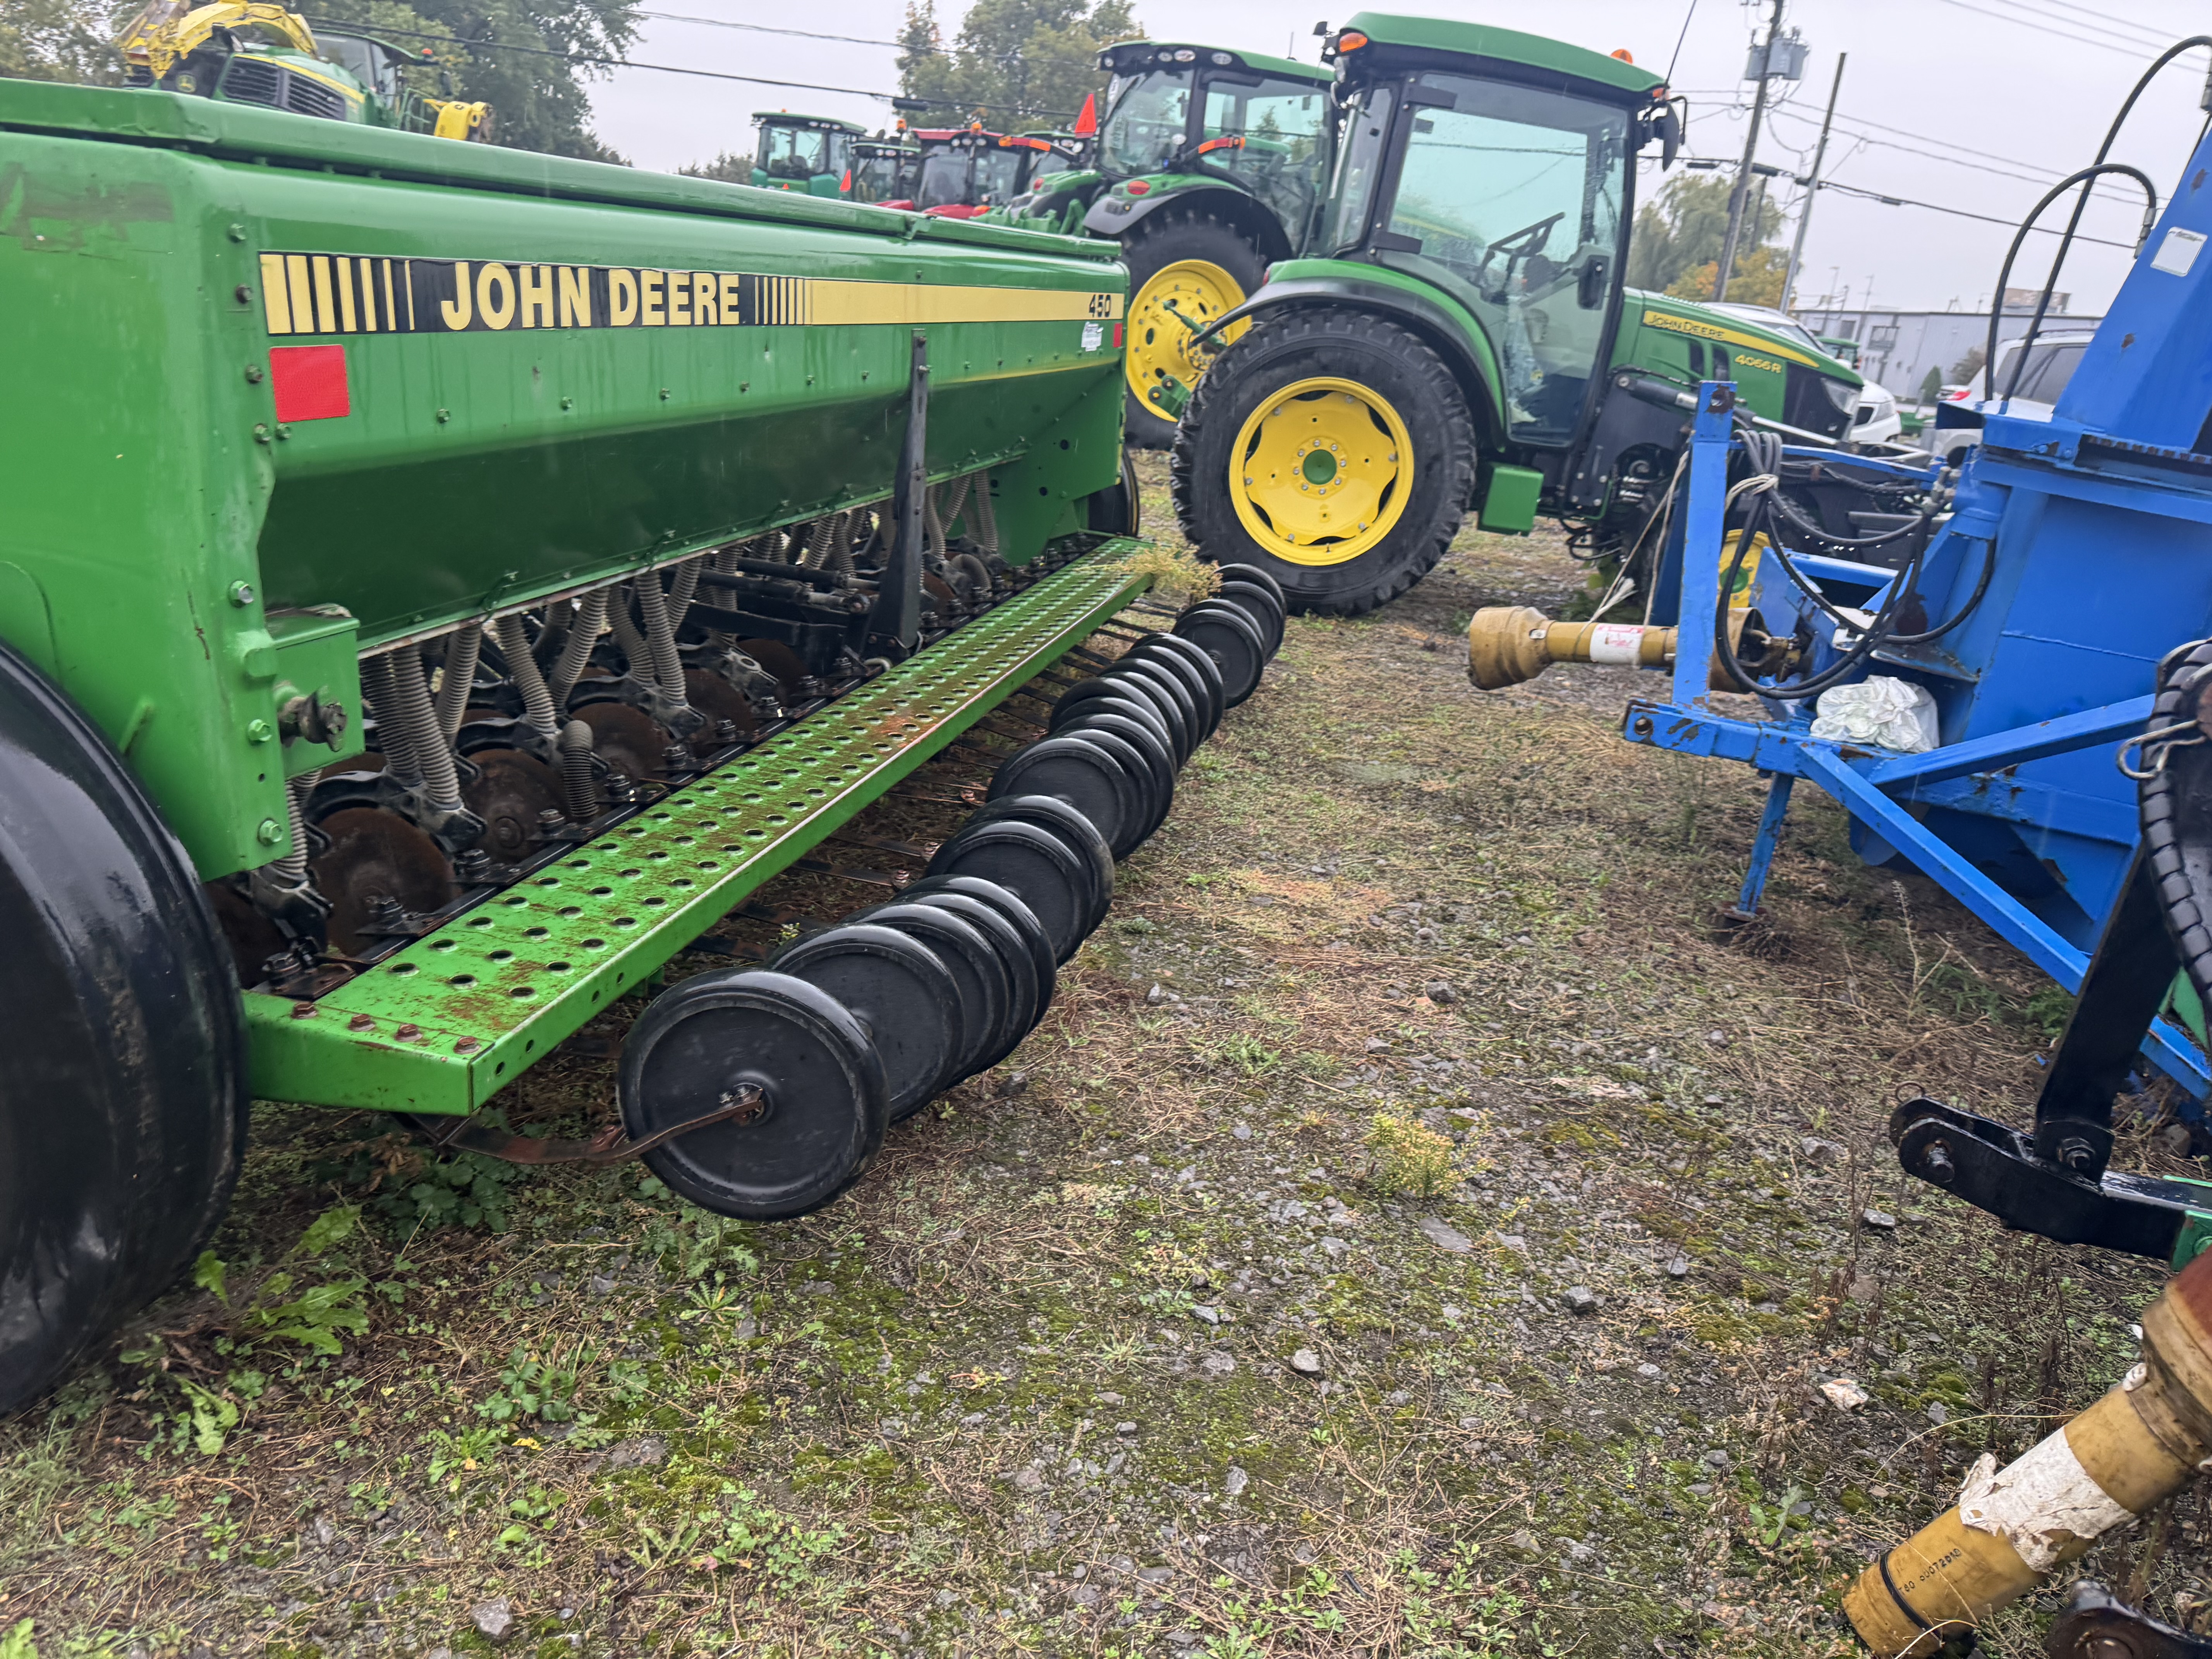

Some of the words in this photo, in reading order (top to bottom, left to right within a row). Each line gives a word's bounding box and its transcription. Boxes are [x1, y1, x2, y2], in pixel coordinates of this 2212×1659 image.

[441, 262, 591, 331] JOHN
[609, 268, 740, 326] DEERE
[1089, 294, 1111, 318] 450
[1649, 314, 1682, 330] JOHN
[1684, 321, 1725, 337] DEERE
